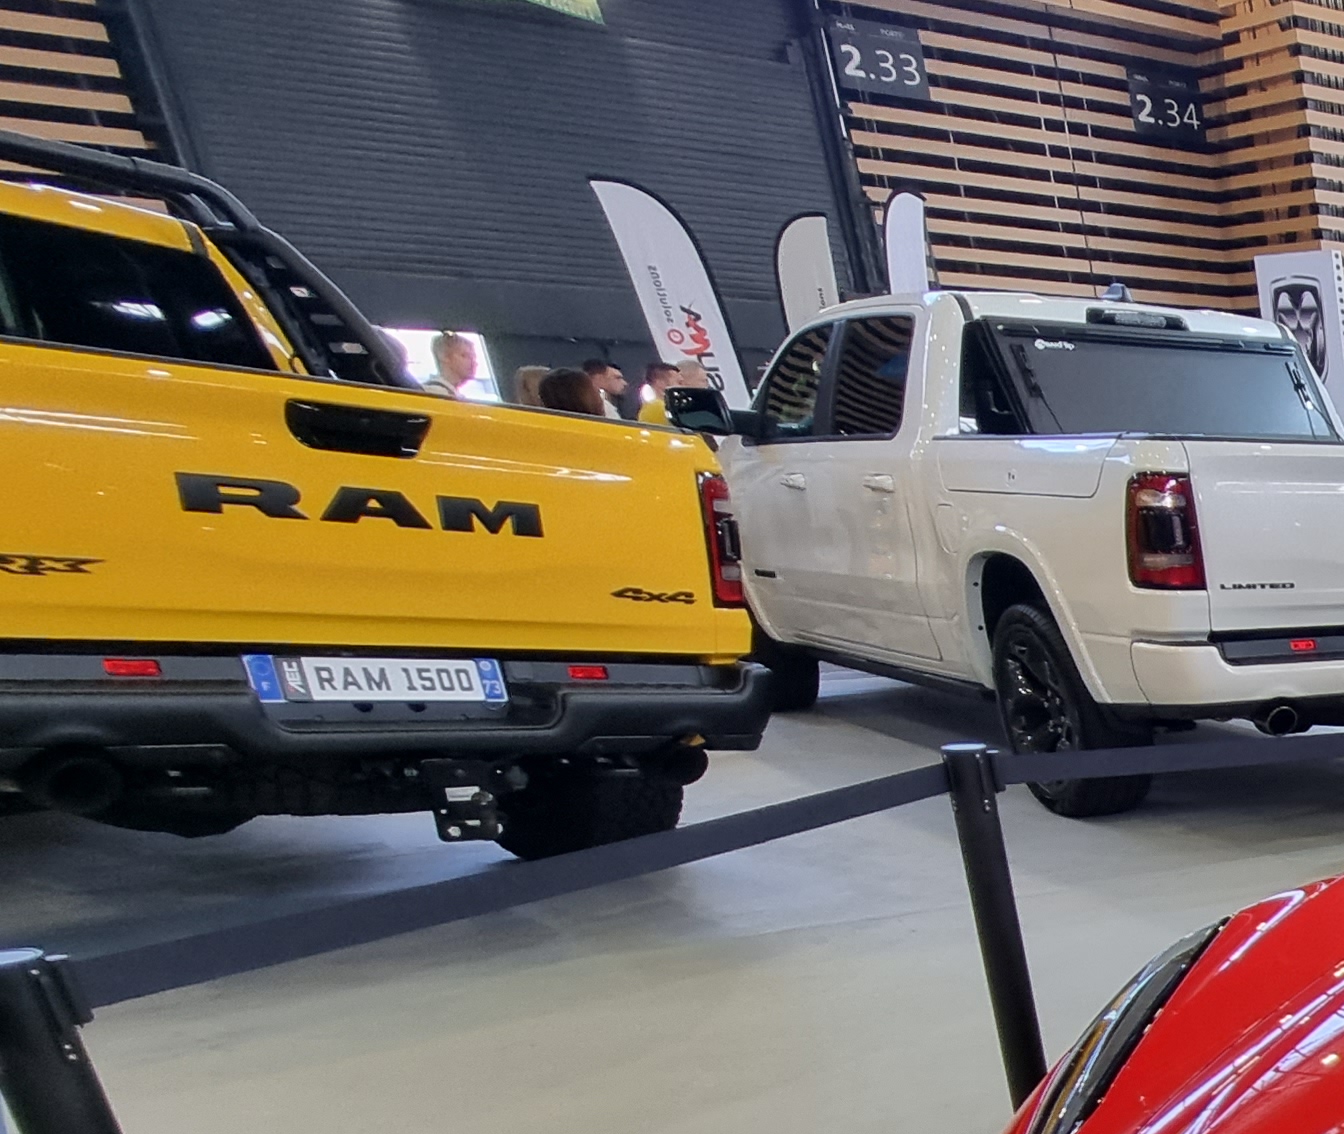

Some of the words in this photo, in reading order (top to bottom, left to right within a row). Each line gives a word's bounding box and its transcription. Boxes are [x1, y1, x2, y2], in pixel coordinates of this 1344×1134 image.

[840, 44, 921, 86] 2.33
[1136, 93, 1201, 130] 2.34
[174, 472, 544, 538] RAM
[1219, 582, 1296, 590] LIMITED
[313, 665, 393, 692] RAM
[401, 667, 475, 692] 1500
[482, 679, 502, 695] 73
